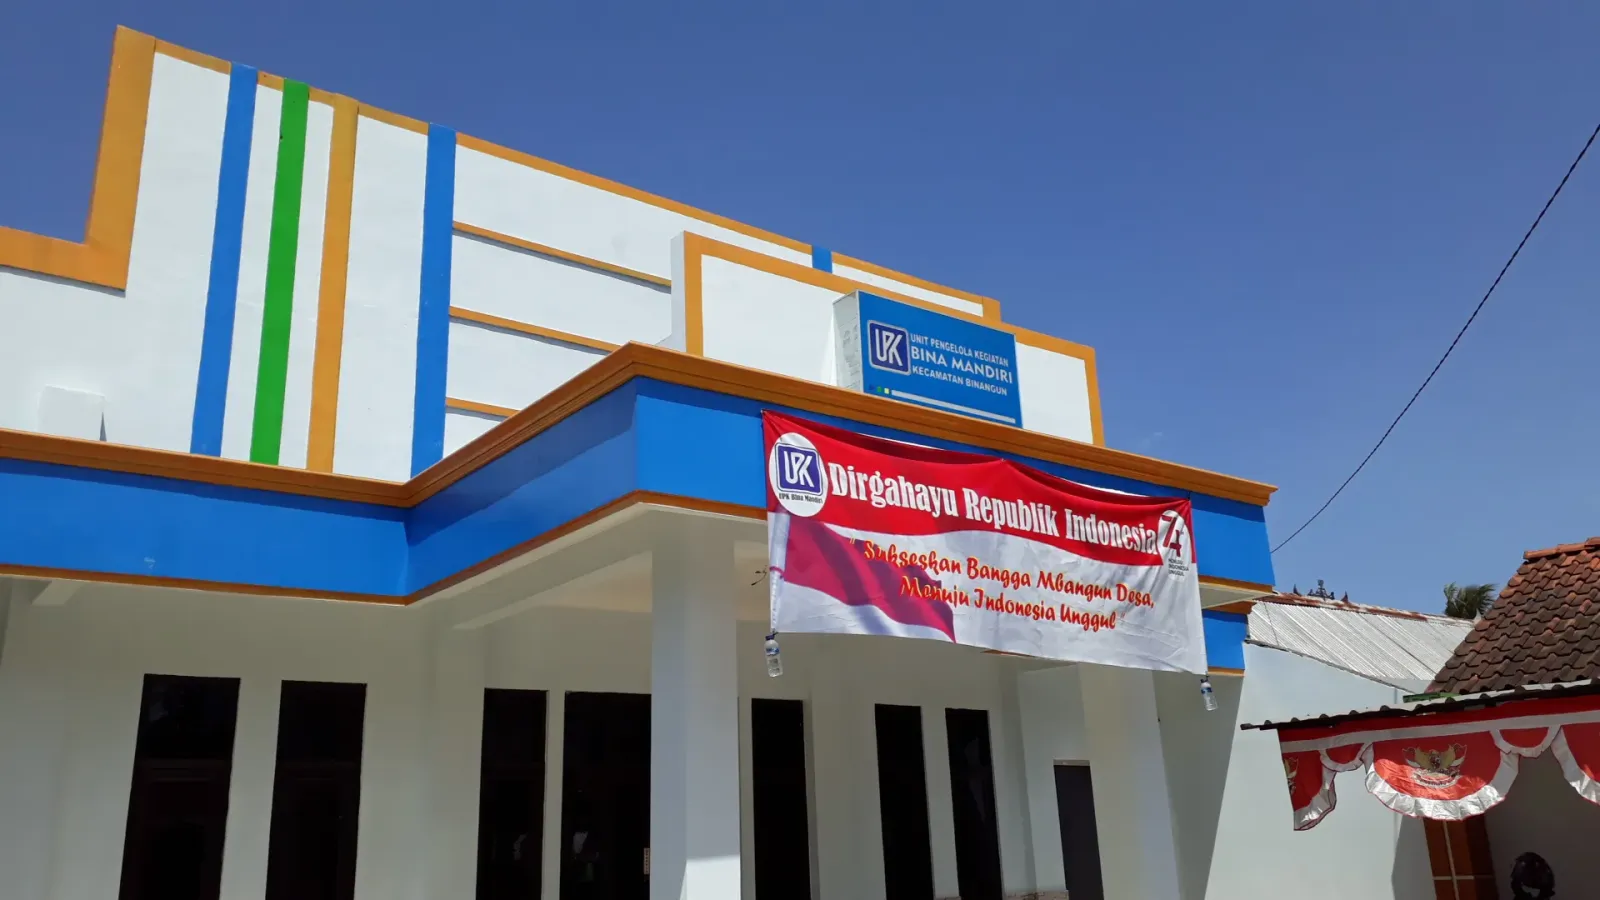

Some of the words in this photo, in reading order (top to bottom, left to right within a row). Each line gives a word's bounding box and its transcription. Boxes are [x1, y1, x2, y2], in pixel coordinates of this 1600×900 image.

[910, 333, 929, 345] UNIT
[930, 338, 973, 357] PENGELOLA
[974, 349, 1009, 367] KEGIATAN
[911, 346, 948, 367] BINA
[951, 357, 1013, 384] MANDIRI
[912, 365, 964, 385] KECAMATAN
[965, 378, 1008, 396] BINANGUN
[828, 462, 959, 518] Dirgahayu
[962, 487, 1060, 537] Republik
[1064, 508, 1159, 555] Indonesia
[863, 539, 962, 576] Sukseskan
[966, 557, 1031, 591] Bangga
[1036, 571, 1112, 602] Mbangun
[1115, 583, 1155, 610] Desa,
[900, 575, 970, 608] Menuju
[974, 588, 1056, 621] Indonesia
[1060, 606, 1117, 633] Unggul
